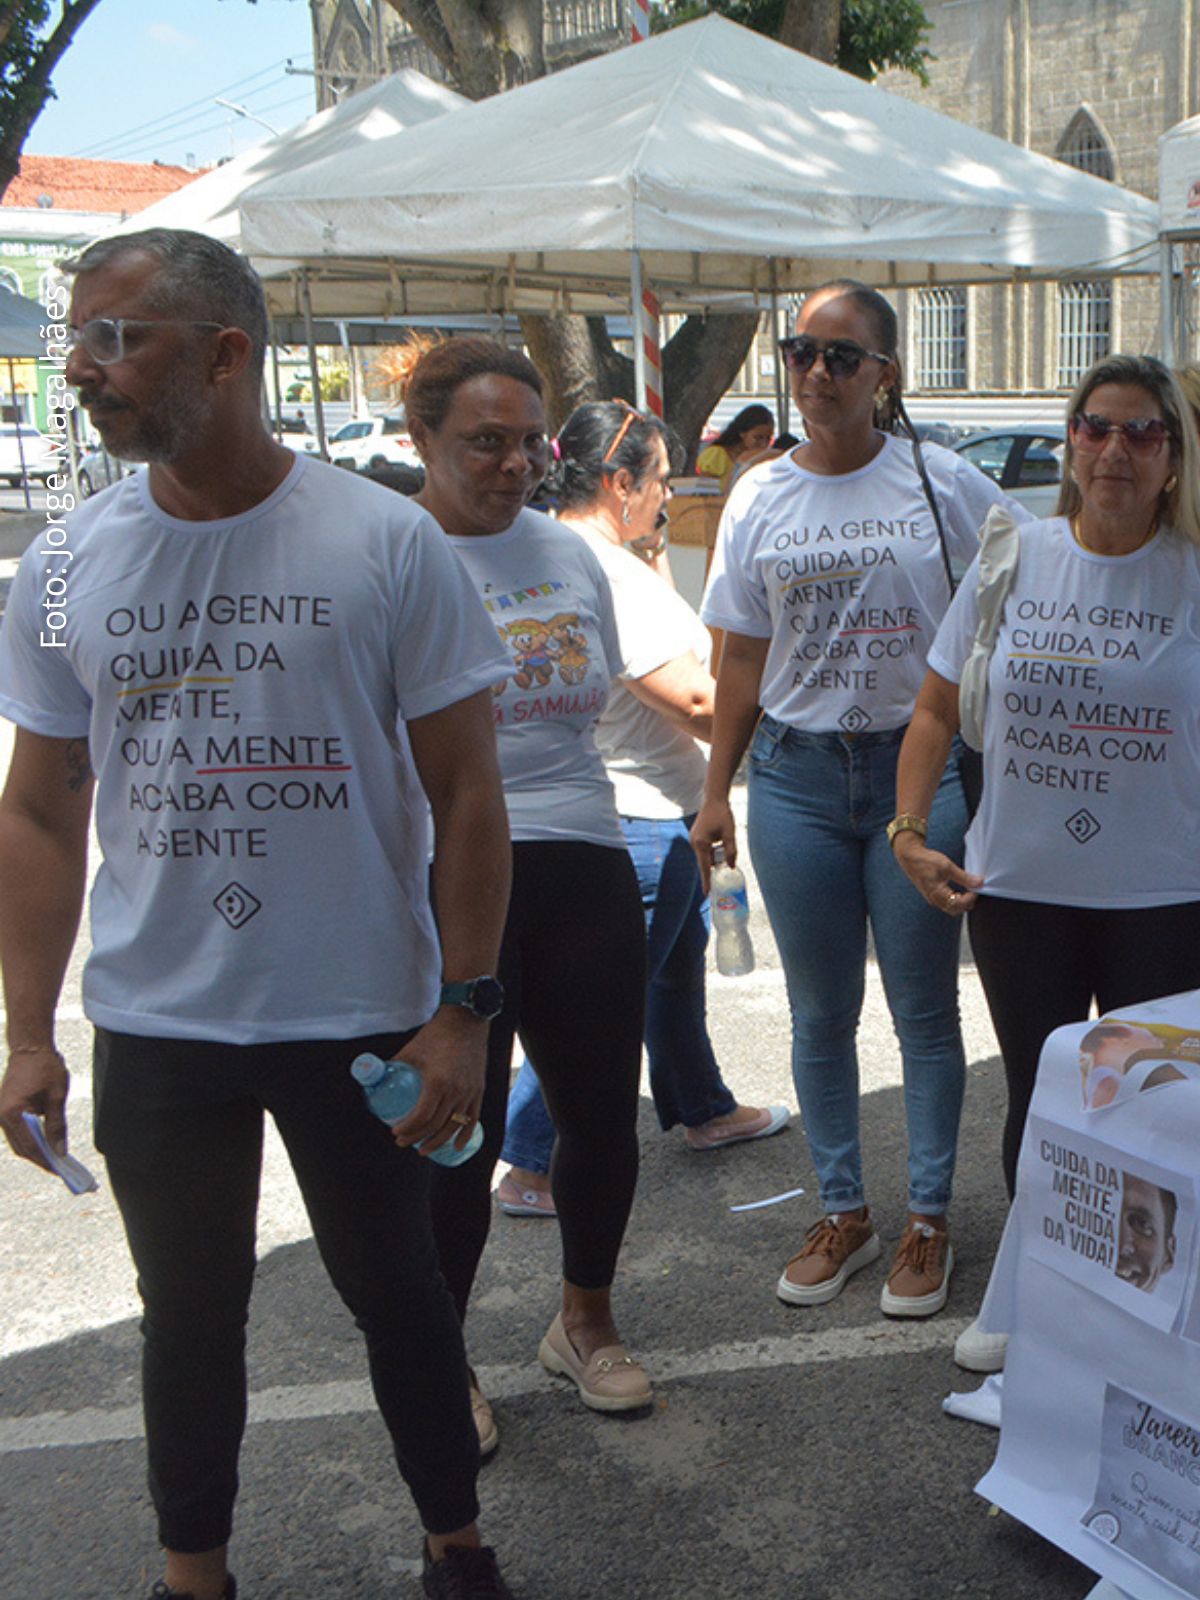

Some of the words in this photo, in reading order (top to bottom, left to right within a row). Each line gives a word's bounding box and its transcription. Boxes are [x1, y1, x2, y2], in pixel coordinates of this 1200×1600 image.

[774, 527, 809, 551] OU
[817, 525, 834, 542] A
[841, 520, 922, 540] GENTE
[776, 549, 854, 581] CUIDA
[862, 546, 897, 568] DA
[783, 578, 866, 609] MENTE,
[106, 603, 165, 637] OU
[178, 601, 200, 630] A
[206, 594, 332, 626] GENTE
[827, 611, 840, 631] A
[843, 606, 920, 629] MENTE
[1017, 600, 1056, 621] OU
[1061, 603, 1081, 623] A
[1088, 606, 1175, 636] GENTE
[236, 642, 285, 672] DA
[866, 636, 915, 660] COM
[1011, 630, 1094, 656] CUIDA
[1103, 639, 1141, 662] DA
[803, 669, 877, 690] GENTE
[1005, 660, 1104, 695] MENTE,
[1004, 692, 1042, 717] OU
[1049, 699, 1068, 721] A
[1075, 701, 1171, 730] MENTE
[121, 738, 163, 766] OU
[168, 737, 194, 765] A
[206, 736, 344, 765] MENTE
[1004, 725, 1092, 758] ACABA
[1100, 737, 1167, 763] COM
[1004, 758, 1020, 780] A
[1026, 762, 1111, 793] GENTE
[130, 783, 235, 811] ACABA
[246, 781, 349, 810] COM
[153, 828, 268, 858] GENTE
[1040, 1139, 1090, 1179] CUIDA
[1095, 1161, 1119, 1191] DA
[1065, 1200, 1114, 1243] CUIDA
[1044, 1215, 1065, 1246] DA
[1070, 1227, 1114, 1269] VIDA!
